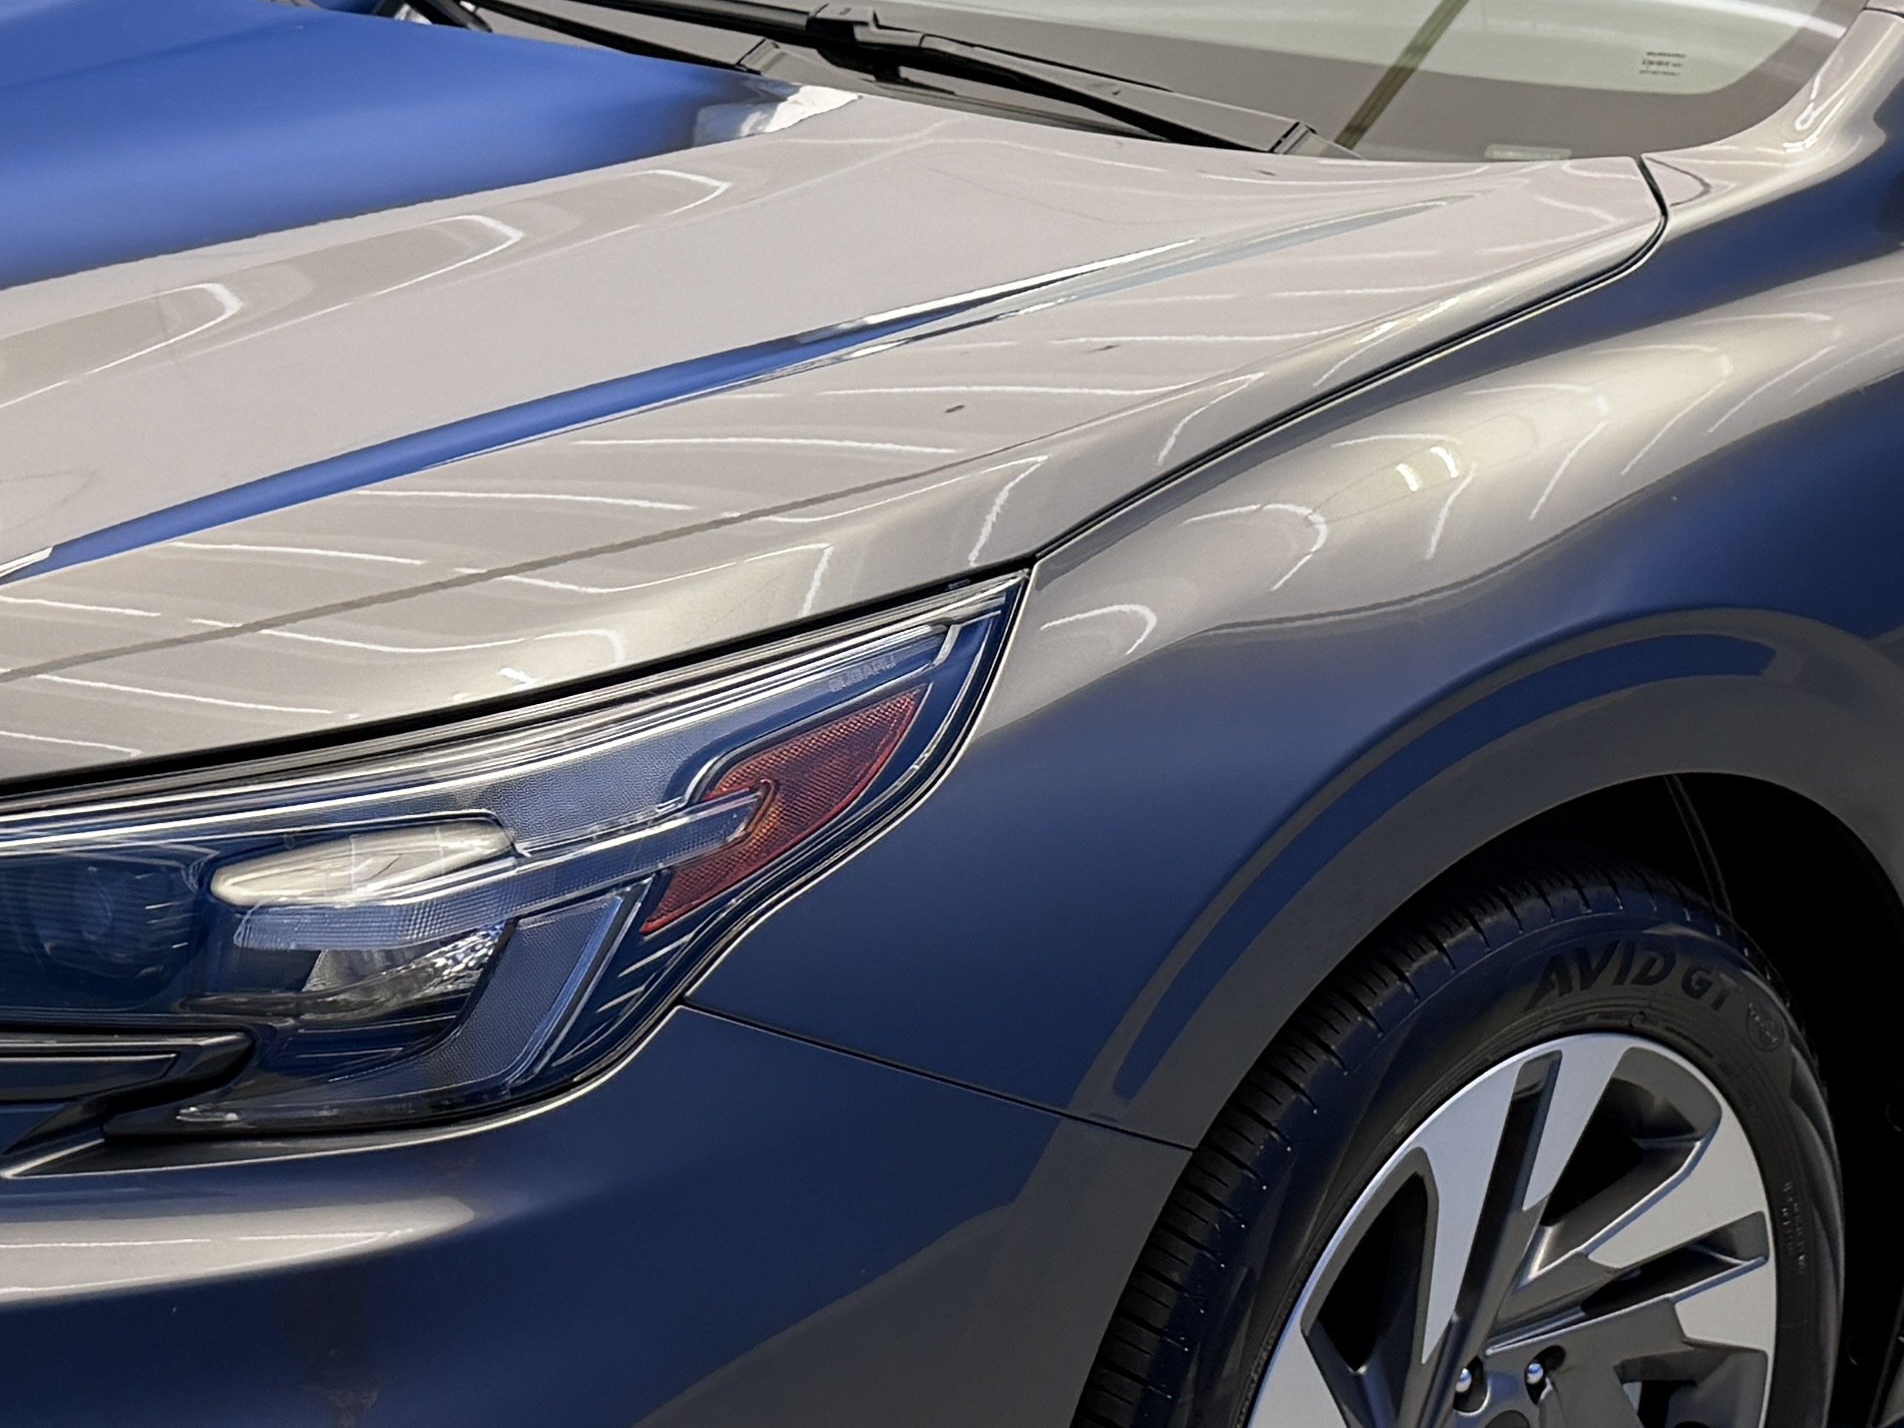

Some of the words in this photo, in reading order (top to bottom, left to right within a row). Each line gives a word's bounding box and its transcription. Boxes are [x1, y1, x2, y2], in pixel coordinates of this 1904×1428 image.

[827, 652, 897, 693] SUBARU
[1524, 939, 1678, 1012] AVID
[1679, 962, 1743, 1013] GT
